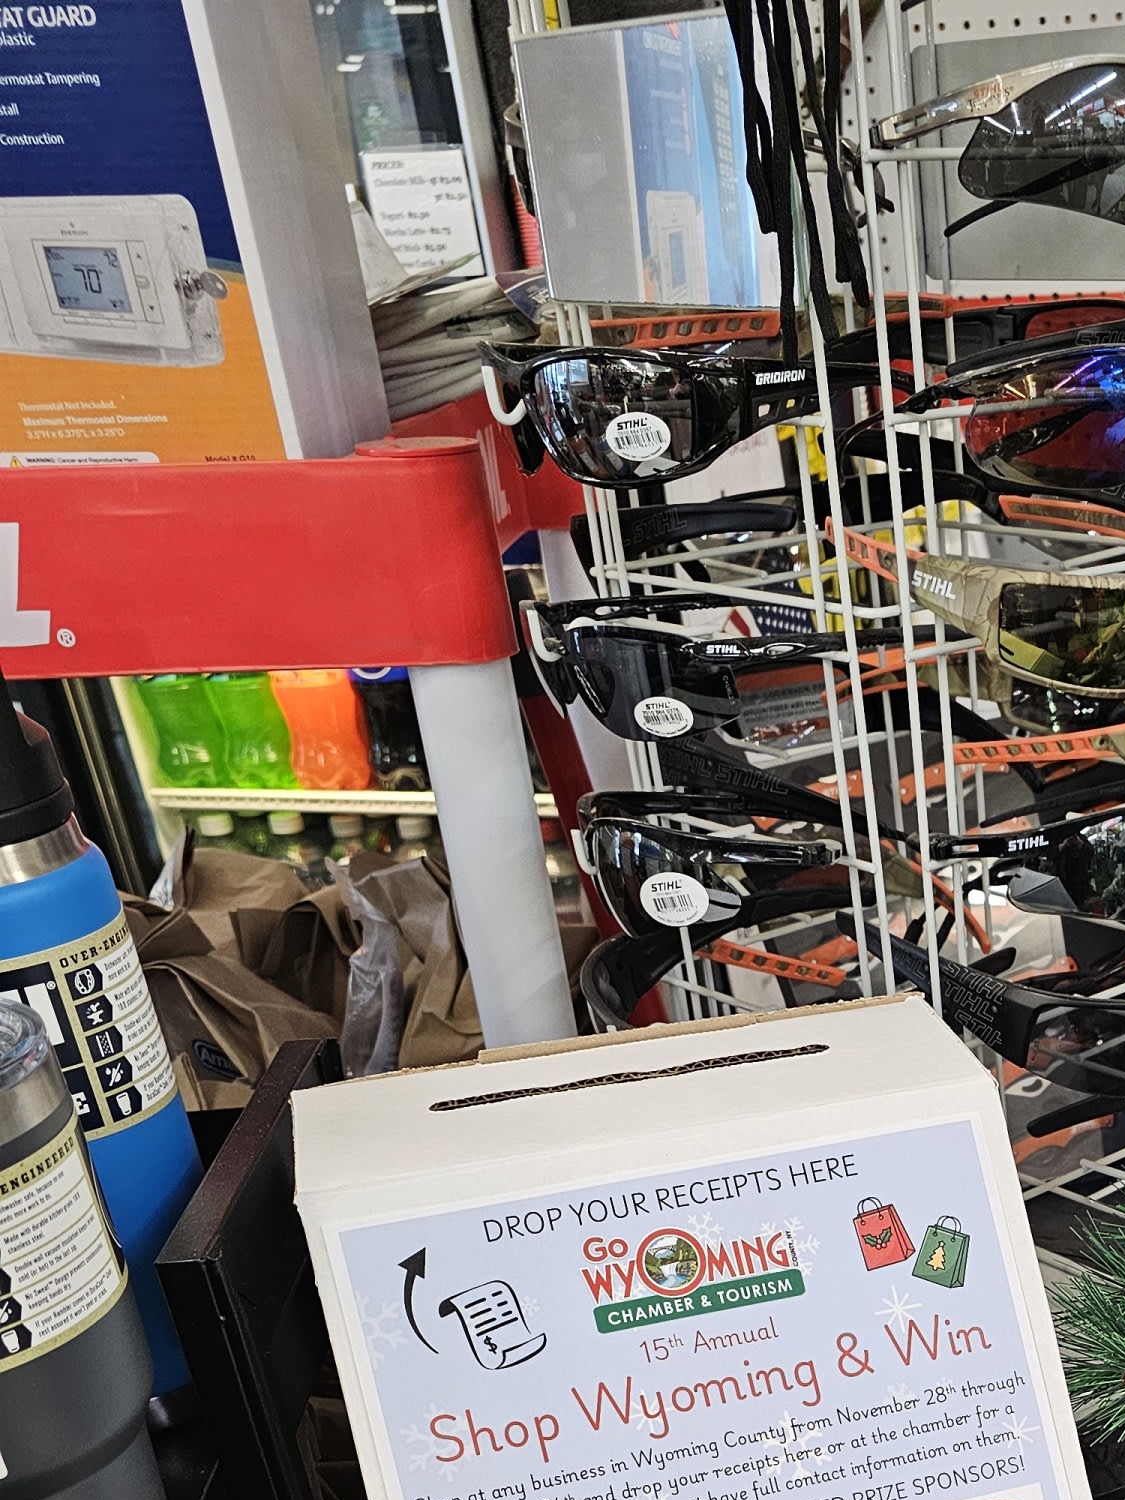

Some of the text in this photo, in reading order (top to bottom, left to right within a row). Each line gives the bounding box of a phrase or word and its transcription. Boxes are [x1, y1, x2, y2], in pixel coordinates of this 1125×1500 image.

[27, 5, 96, 27] GUARD
[44, 71, 100, 87] Tampering
[1, 132, 65, 145] Construction
[755, 368, 806, 386] GRIDIRON
[616, 417, 647, 432] STIHL
[911, 570, 956, 600] STIHL
[705, 643, 741, 656] STIHL
[1008, 834, 1049, 852] STIHL
[0, 1136, 75, 1195] ENGINEERED
[482, 1153, 860, 1244] DROP YOUR RECEIPTS HERE
[581, 1227, 790, 1304] WYOMING
[582, 1236, 629, 1262] Go
[607, 1278, 793, 1326] CHAMBER & TOURISM
[639, 1315, 780, 1364] 15th Annual
[429, 1313, 993, 1464] Shop Wyoming & Win
[529, 1465, 607, 1492] business
[609, 1458, 630, 1474] in
[629, 1440, 720, 1472] Wyoming
[723, 1425, 788, 1449] County
[789, 1417, 834, 1443] from
[835, 1395, 921, 1426] November
[922, 1383, 957, 1407] 28th
[960, 1369, 1027, 1399] through
[621, 1480, 663, 1500] drop
[667, 1471, 710, 1497] your
[711, 1454, 781, 1480] receipts
[782, 1446, 823, 1464] here
[826, 1441, 846, 1455] or
[850, 1433, 869, 1450] at
[870, 1426, 899, 1445] the
[901, 1411, 973, 1439] chamber
[975, 1404, 1001, 1429] for
[1004, 1404, 1016, 1416] a
[784, 1465, 848, 1491] contact
[849, 1445, 949, 1481] information
[951, 1440, 973, 1454] on
[974, 1429, 1021, 1448] them.
[911, 1454, 1026, 1497] SPONSORS!
